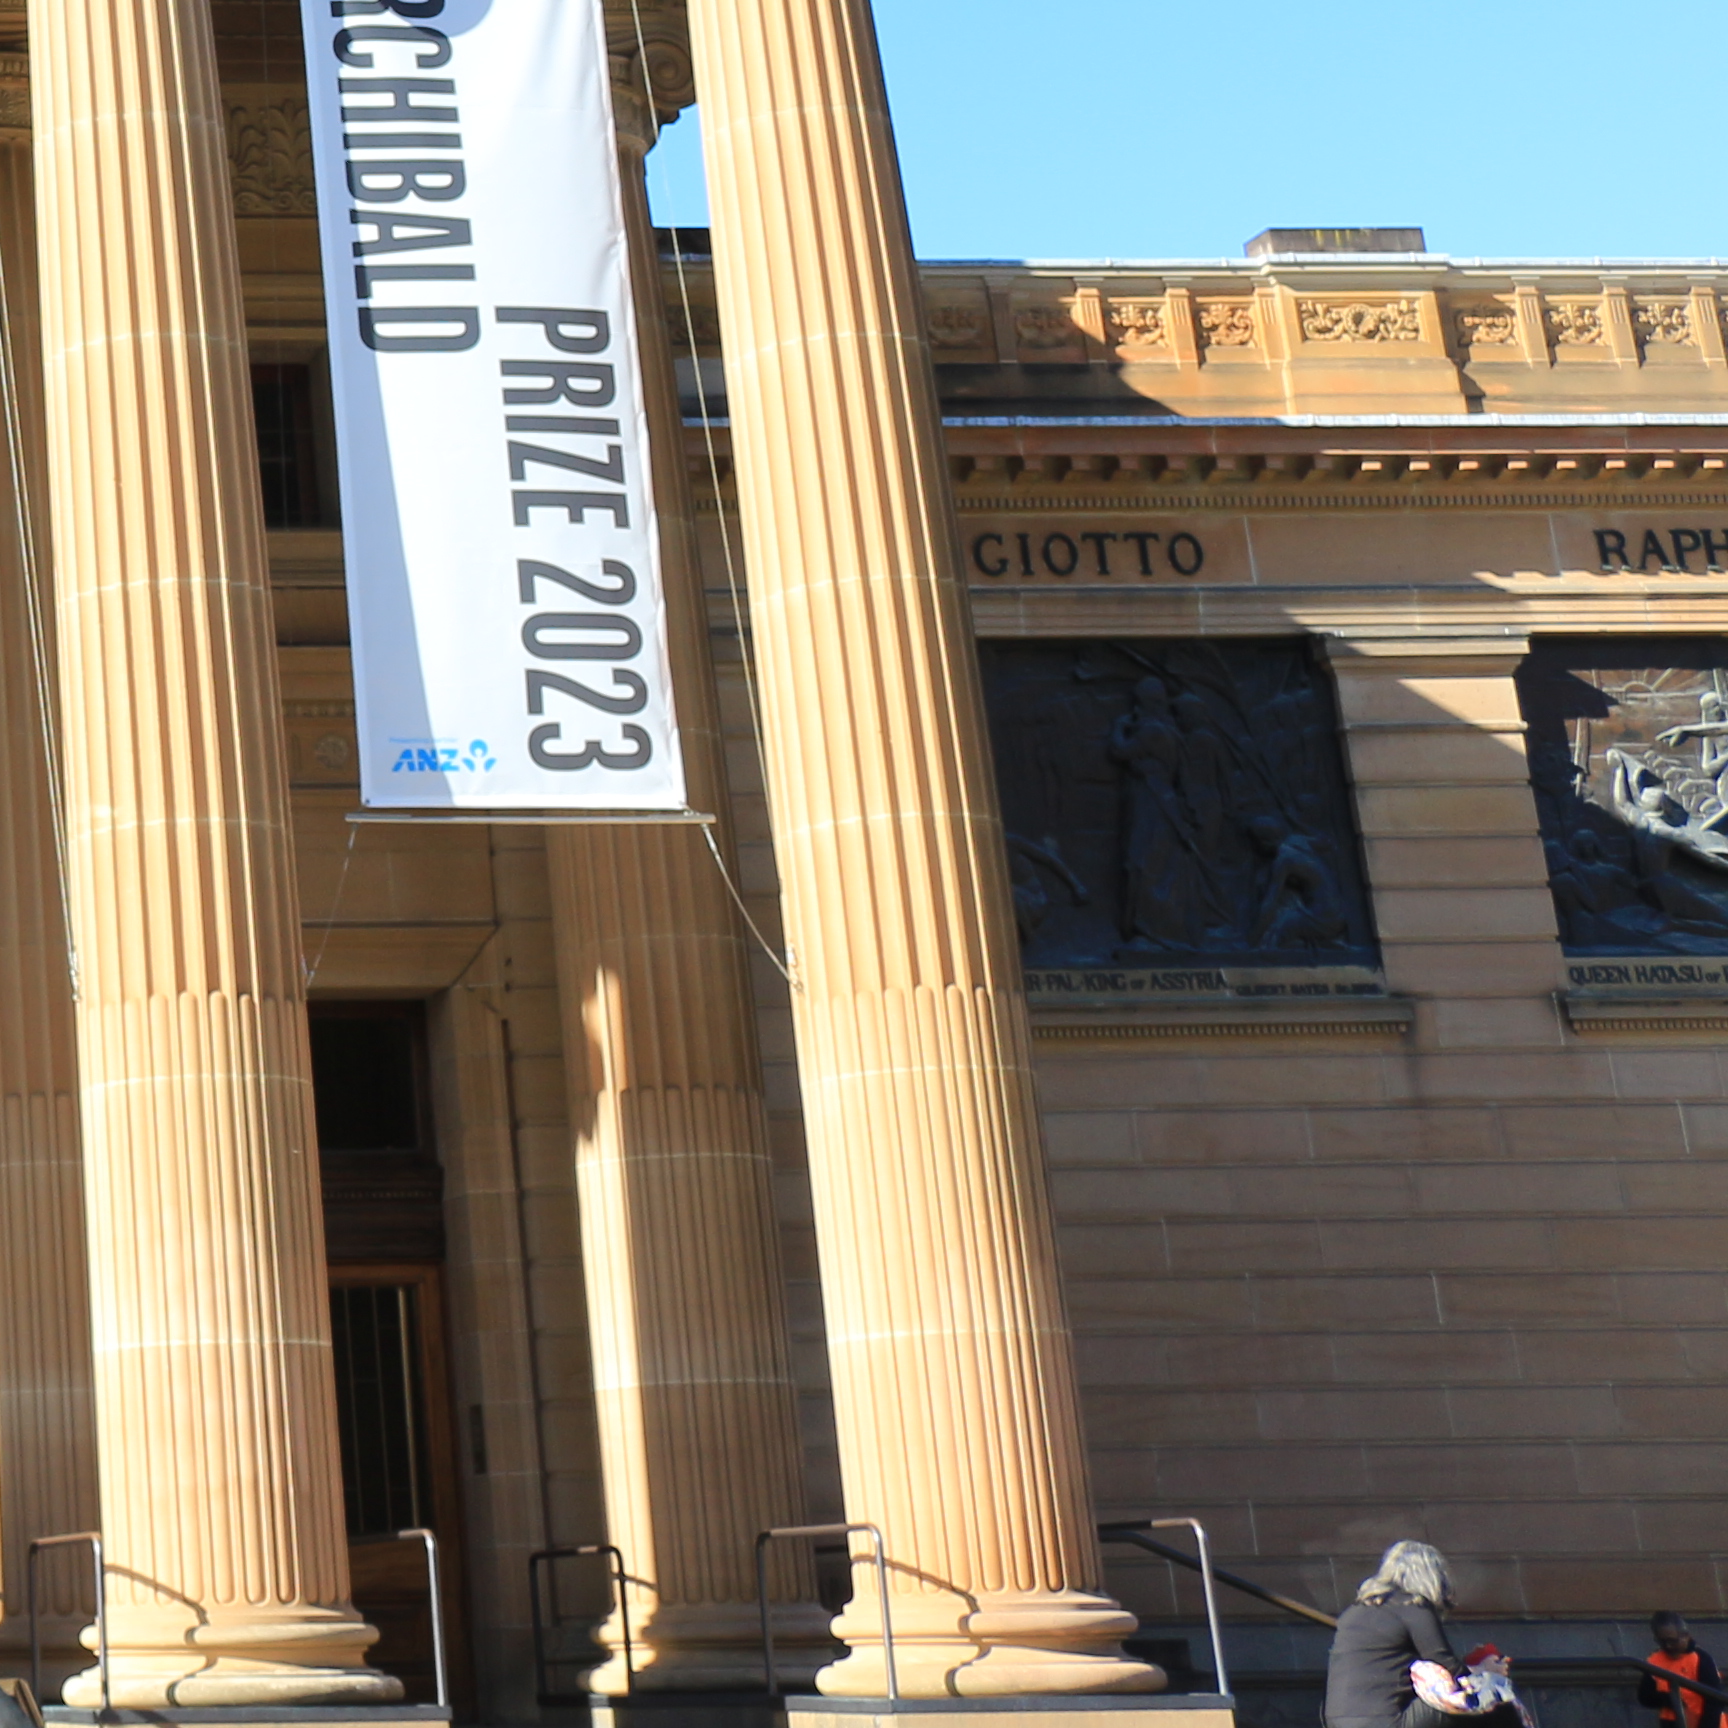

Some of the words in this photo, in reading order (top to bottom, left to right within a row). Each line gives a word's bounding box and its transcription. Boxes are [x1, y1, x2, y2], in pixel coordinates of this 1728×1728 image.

[494, 305, 631, 529] PRIZE
[972, 530, 1205, 576] GIOTTO
[1592, 528, 1728, 573] RAPH
[516, 558, 654, 773] 2023
[391, 748, 460, 773] ANZ
[1569, 965, 1632, 985] QUEEN
